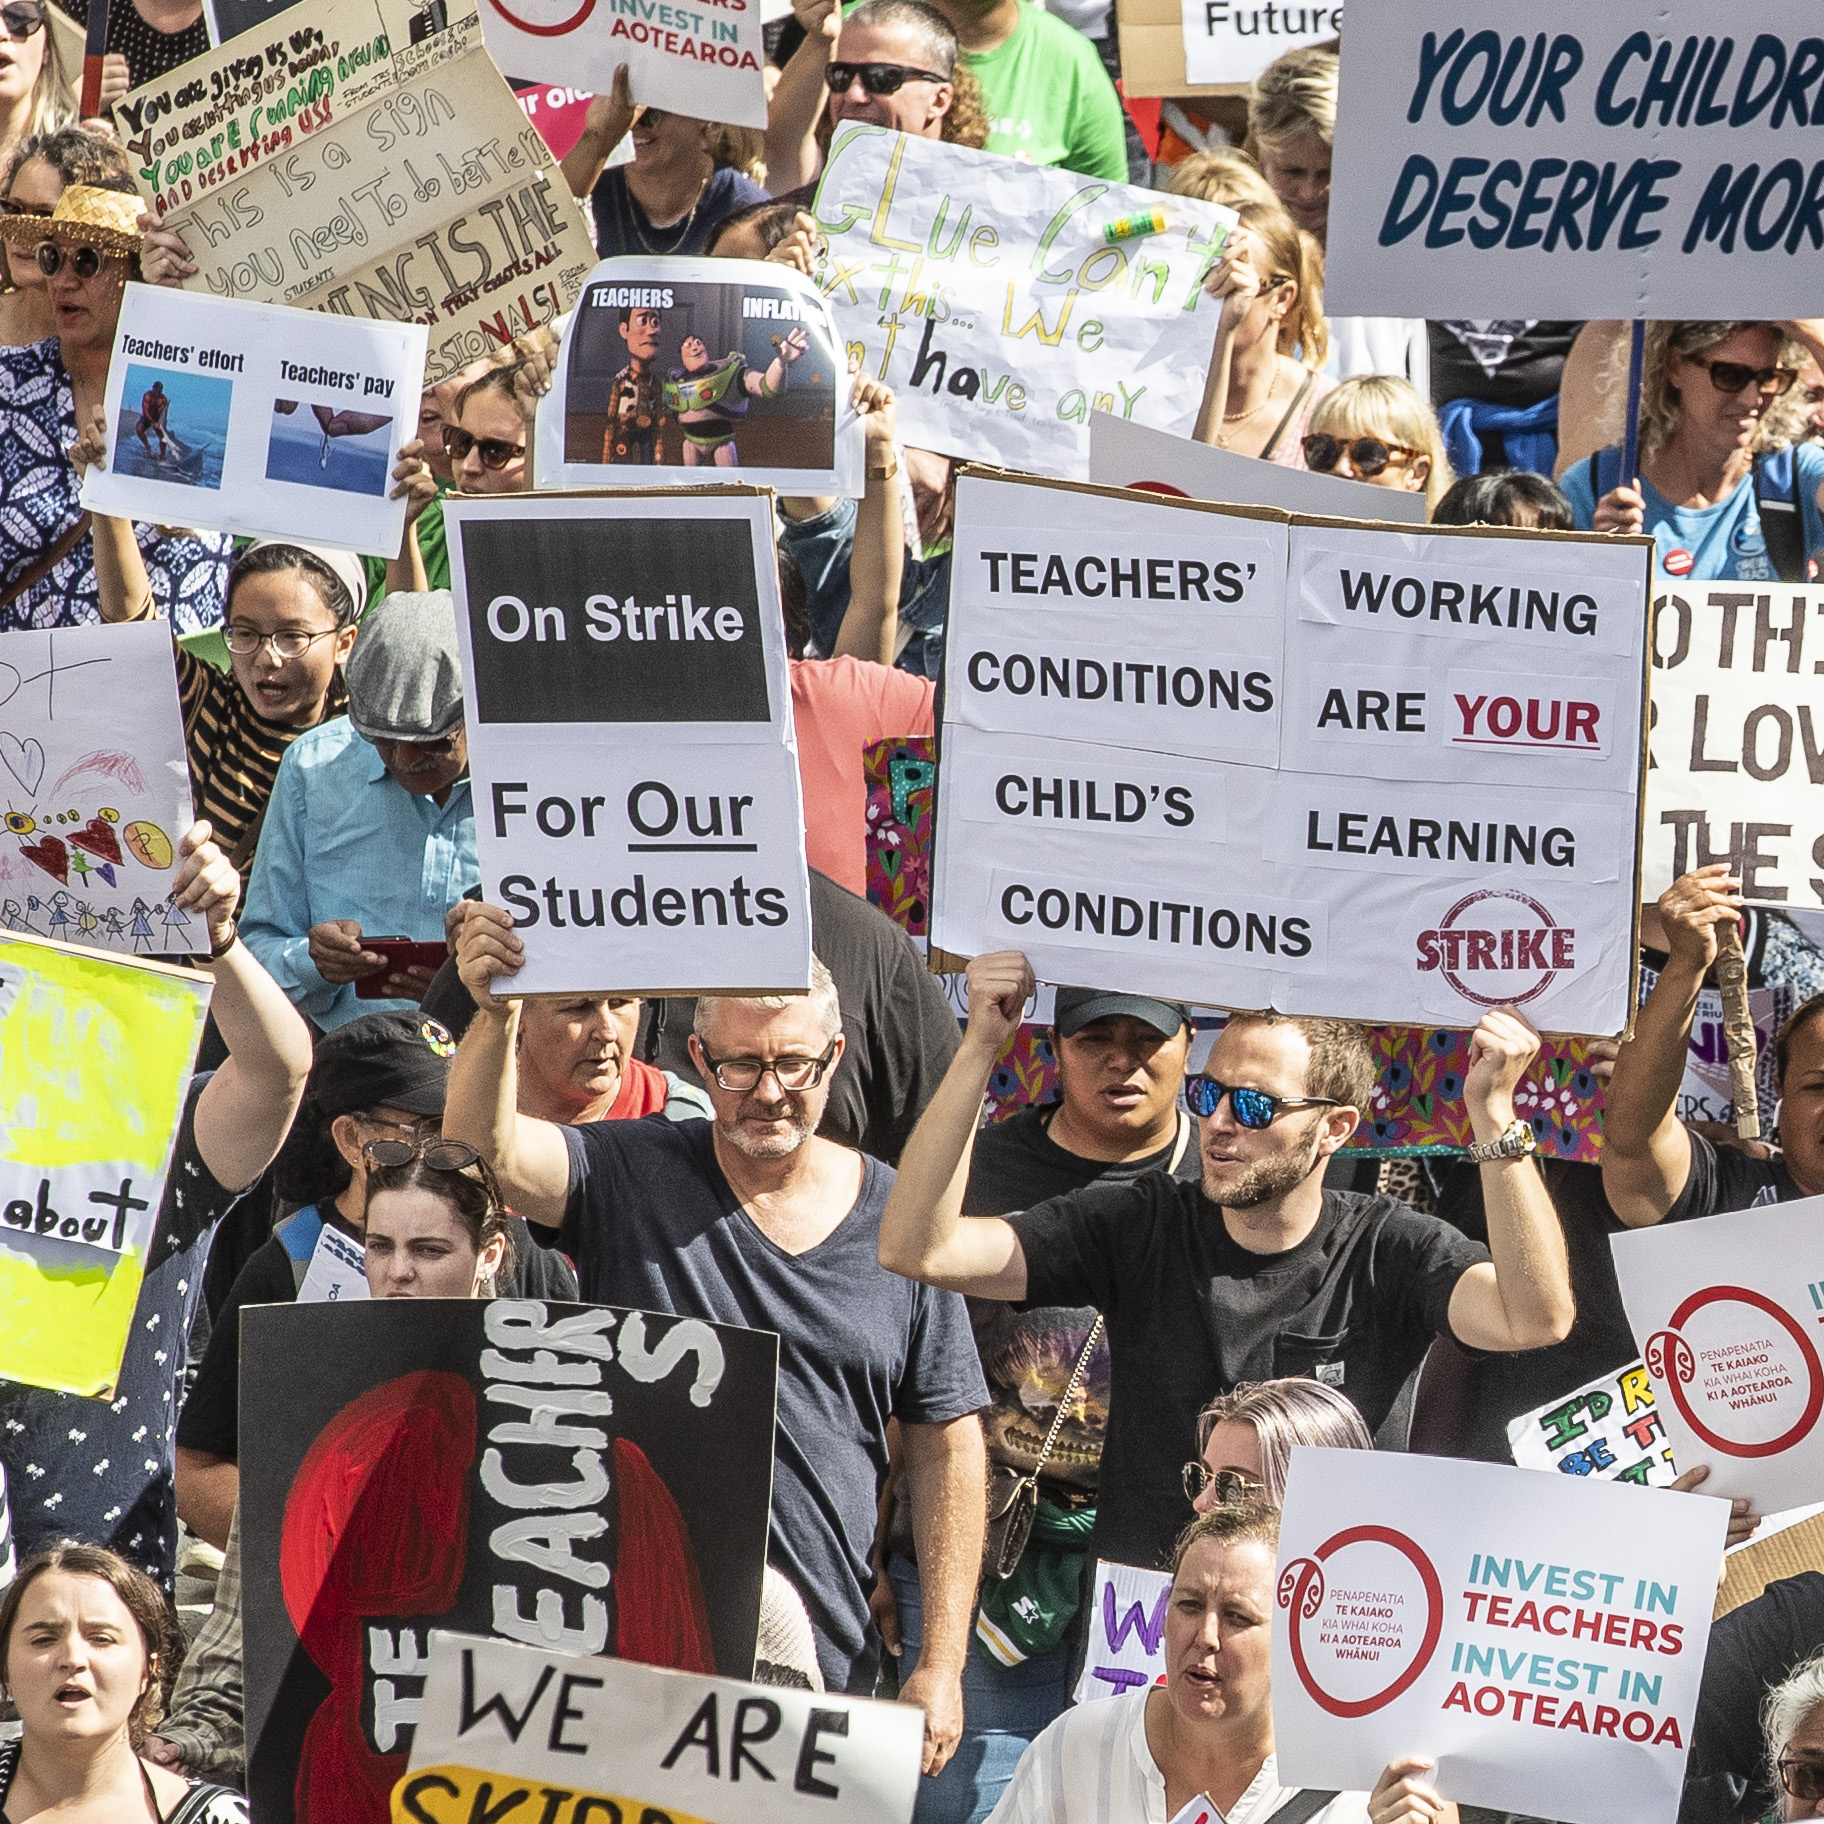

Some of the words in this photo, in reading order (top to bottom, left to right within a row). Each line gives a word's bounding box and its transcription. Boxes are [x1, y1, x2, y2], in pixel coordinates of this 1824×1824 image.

[121, 333, 194, 367] Teachers'
[199, 348, 245, 374] effort
[279, 359, 361, 393] Teachers'
[364, 374, 395, 400] pay
[980, 551, 1258, 603] TEACHERS'
[1339, 569, 1599, 635] WORKING
[486, 597, 568, 643] On
[585, 595, 744, 643] Strike
[967, 650, 1273, 712] CONDITIONS
[1317, 687, 1427, 734] ARE
[1453, 693, 1601, 744] YOUR
[491, 782, 605, 838] For
[627, 781, 754, 838] Our
[995, 775, 1195, 827] CHILD'S
[1307, 811, 1575, 868] LEARNING
[499, 872, 788, 929] Students
[1000, 883, 1312, 958] CONDITIONS
[1416, 926, 1575, 972] STRIKE
[1329, 1589, 1405, 1605] PENAPENATIA
[1336, 1605, 1348, 1616] TE
[1350, 1606, 1394, 1619] KAIAKO
[1322, 1619, 1339, 1630] KIA
[1341, 1621, 1369, 1632] WHAI
[1371, 1623, 1403, 1634] KOHA
[1342, 1635, 1402, 1649] AOTEAROA
[459, 1651, 603, 1755] WE
[662, 1693, 850, 1799] ARE
